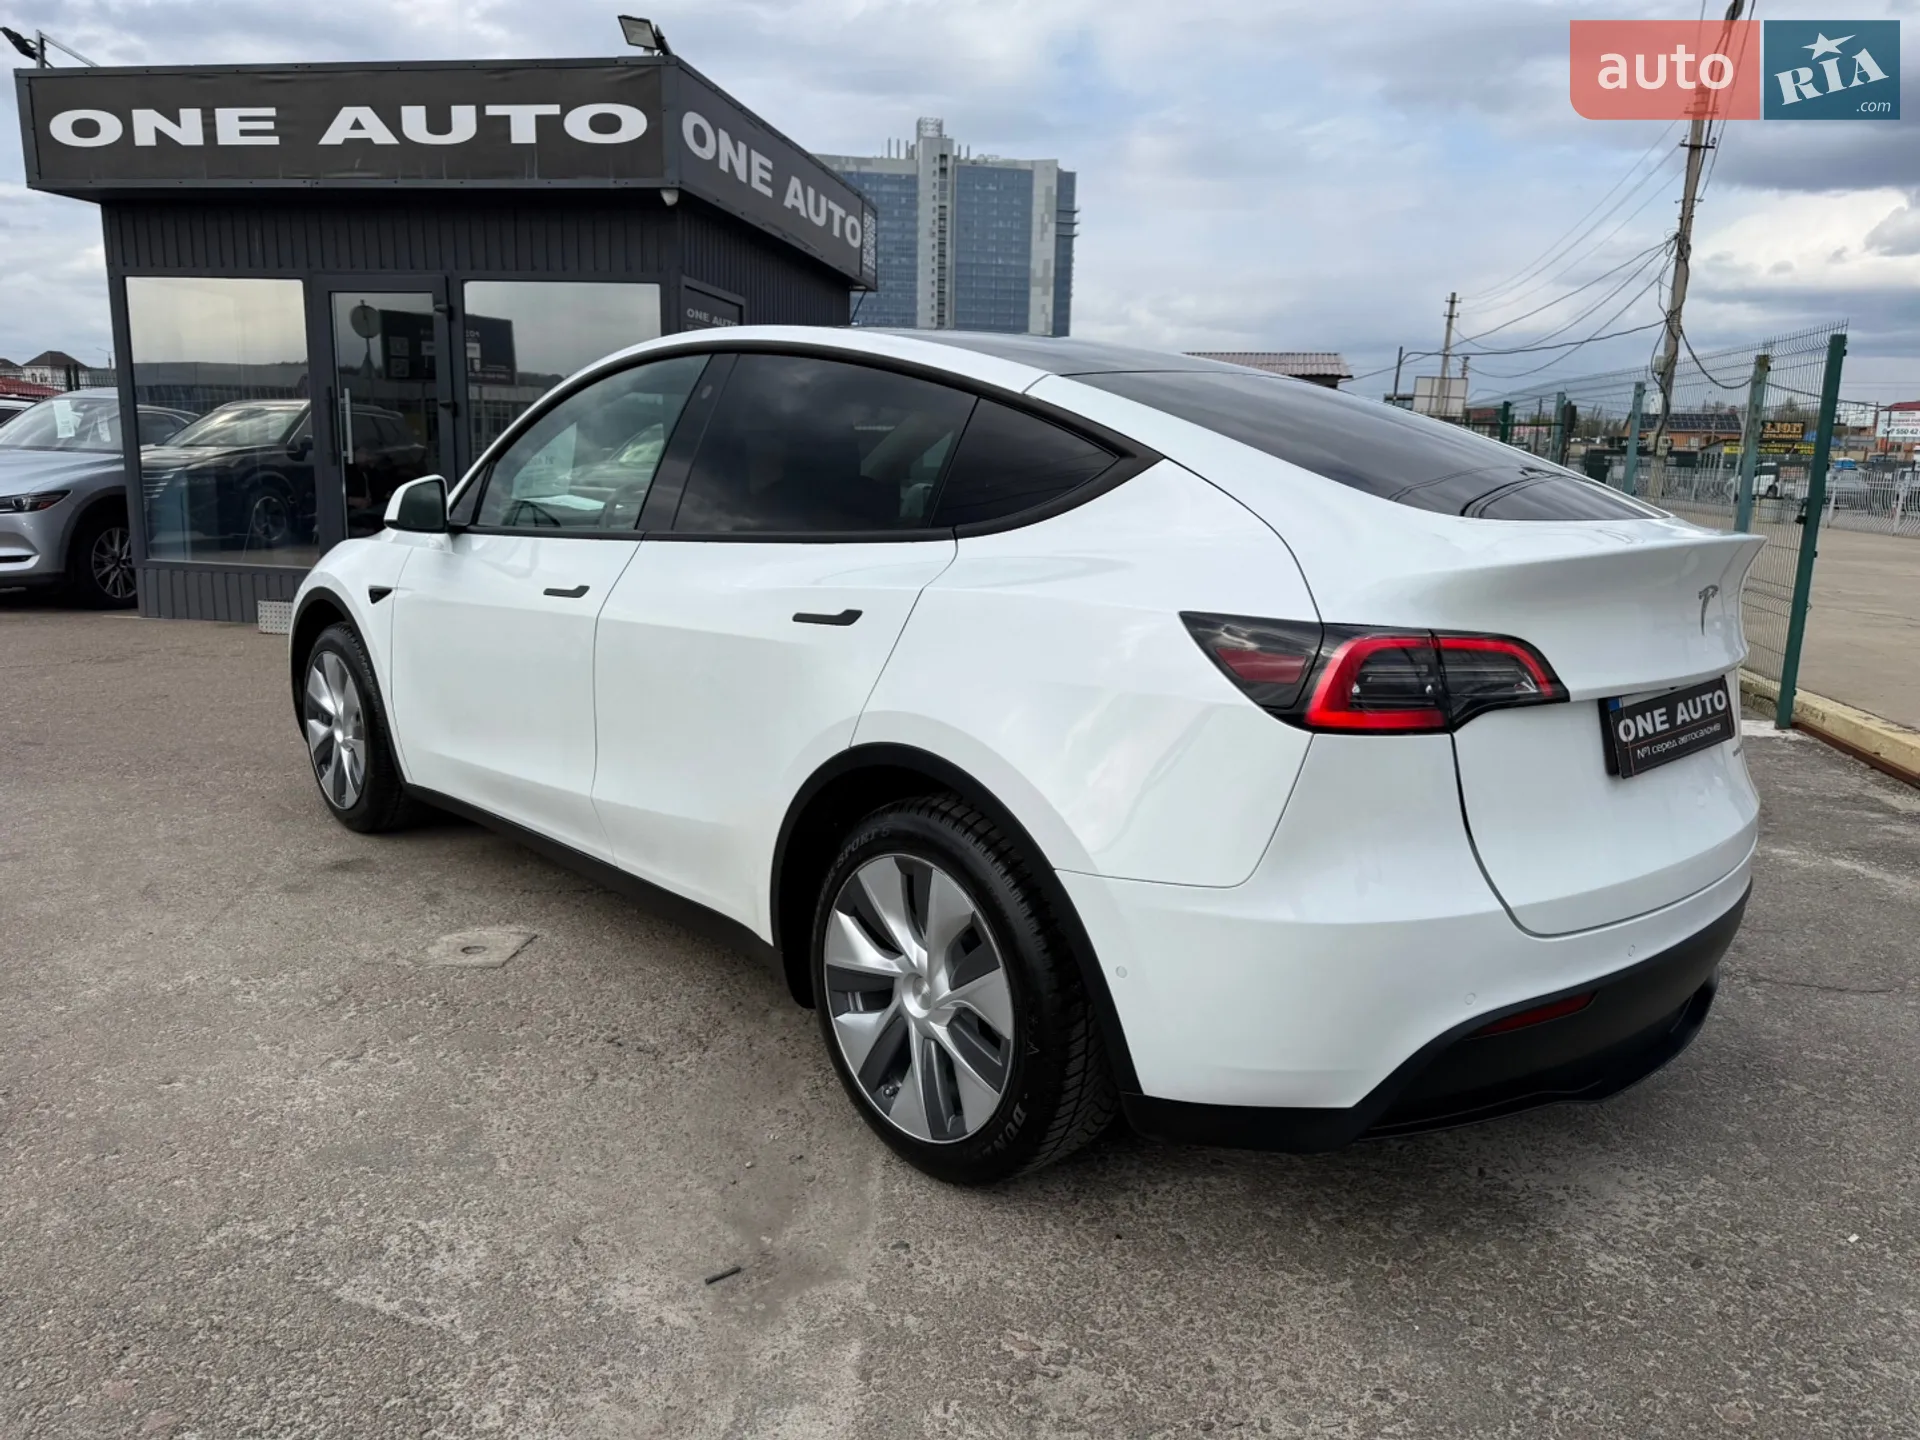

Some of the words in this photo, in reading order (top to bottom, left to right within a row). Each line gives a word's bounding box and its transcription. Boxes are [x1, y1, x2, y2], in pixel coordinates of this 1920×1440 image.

[48, 107, 281, 148] ONE
[317, 102, 648, 146] AUTO
[682, 111, 774, 198] ONE
[783, 175, 862, 249] AUTO
[686, 308, 710, 322] ONE
[1618, 707, 1670, 742] ONE
[1676, 689, 1727, 725] AUTO
[836, 828, 876, 869] SPORT
